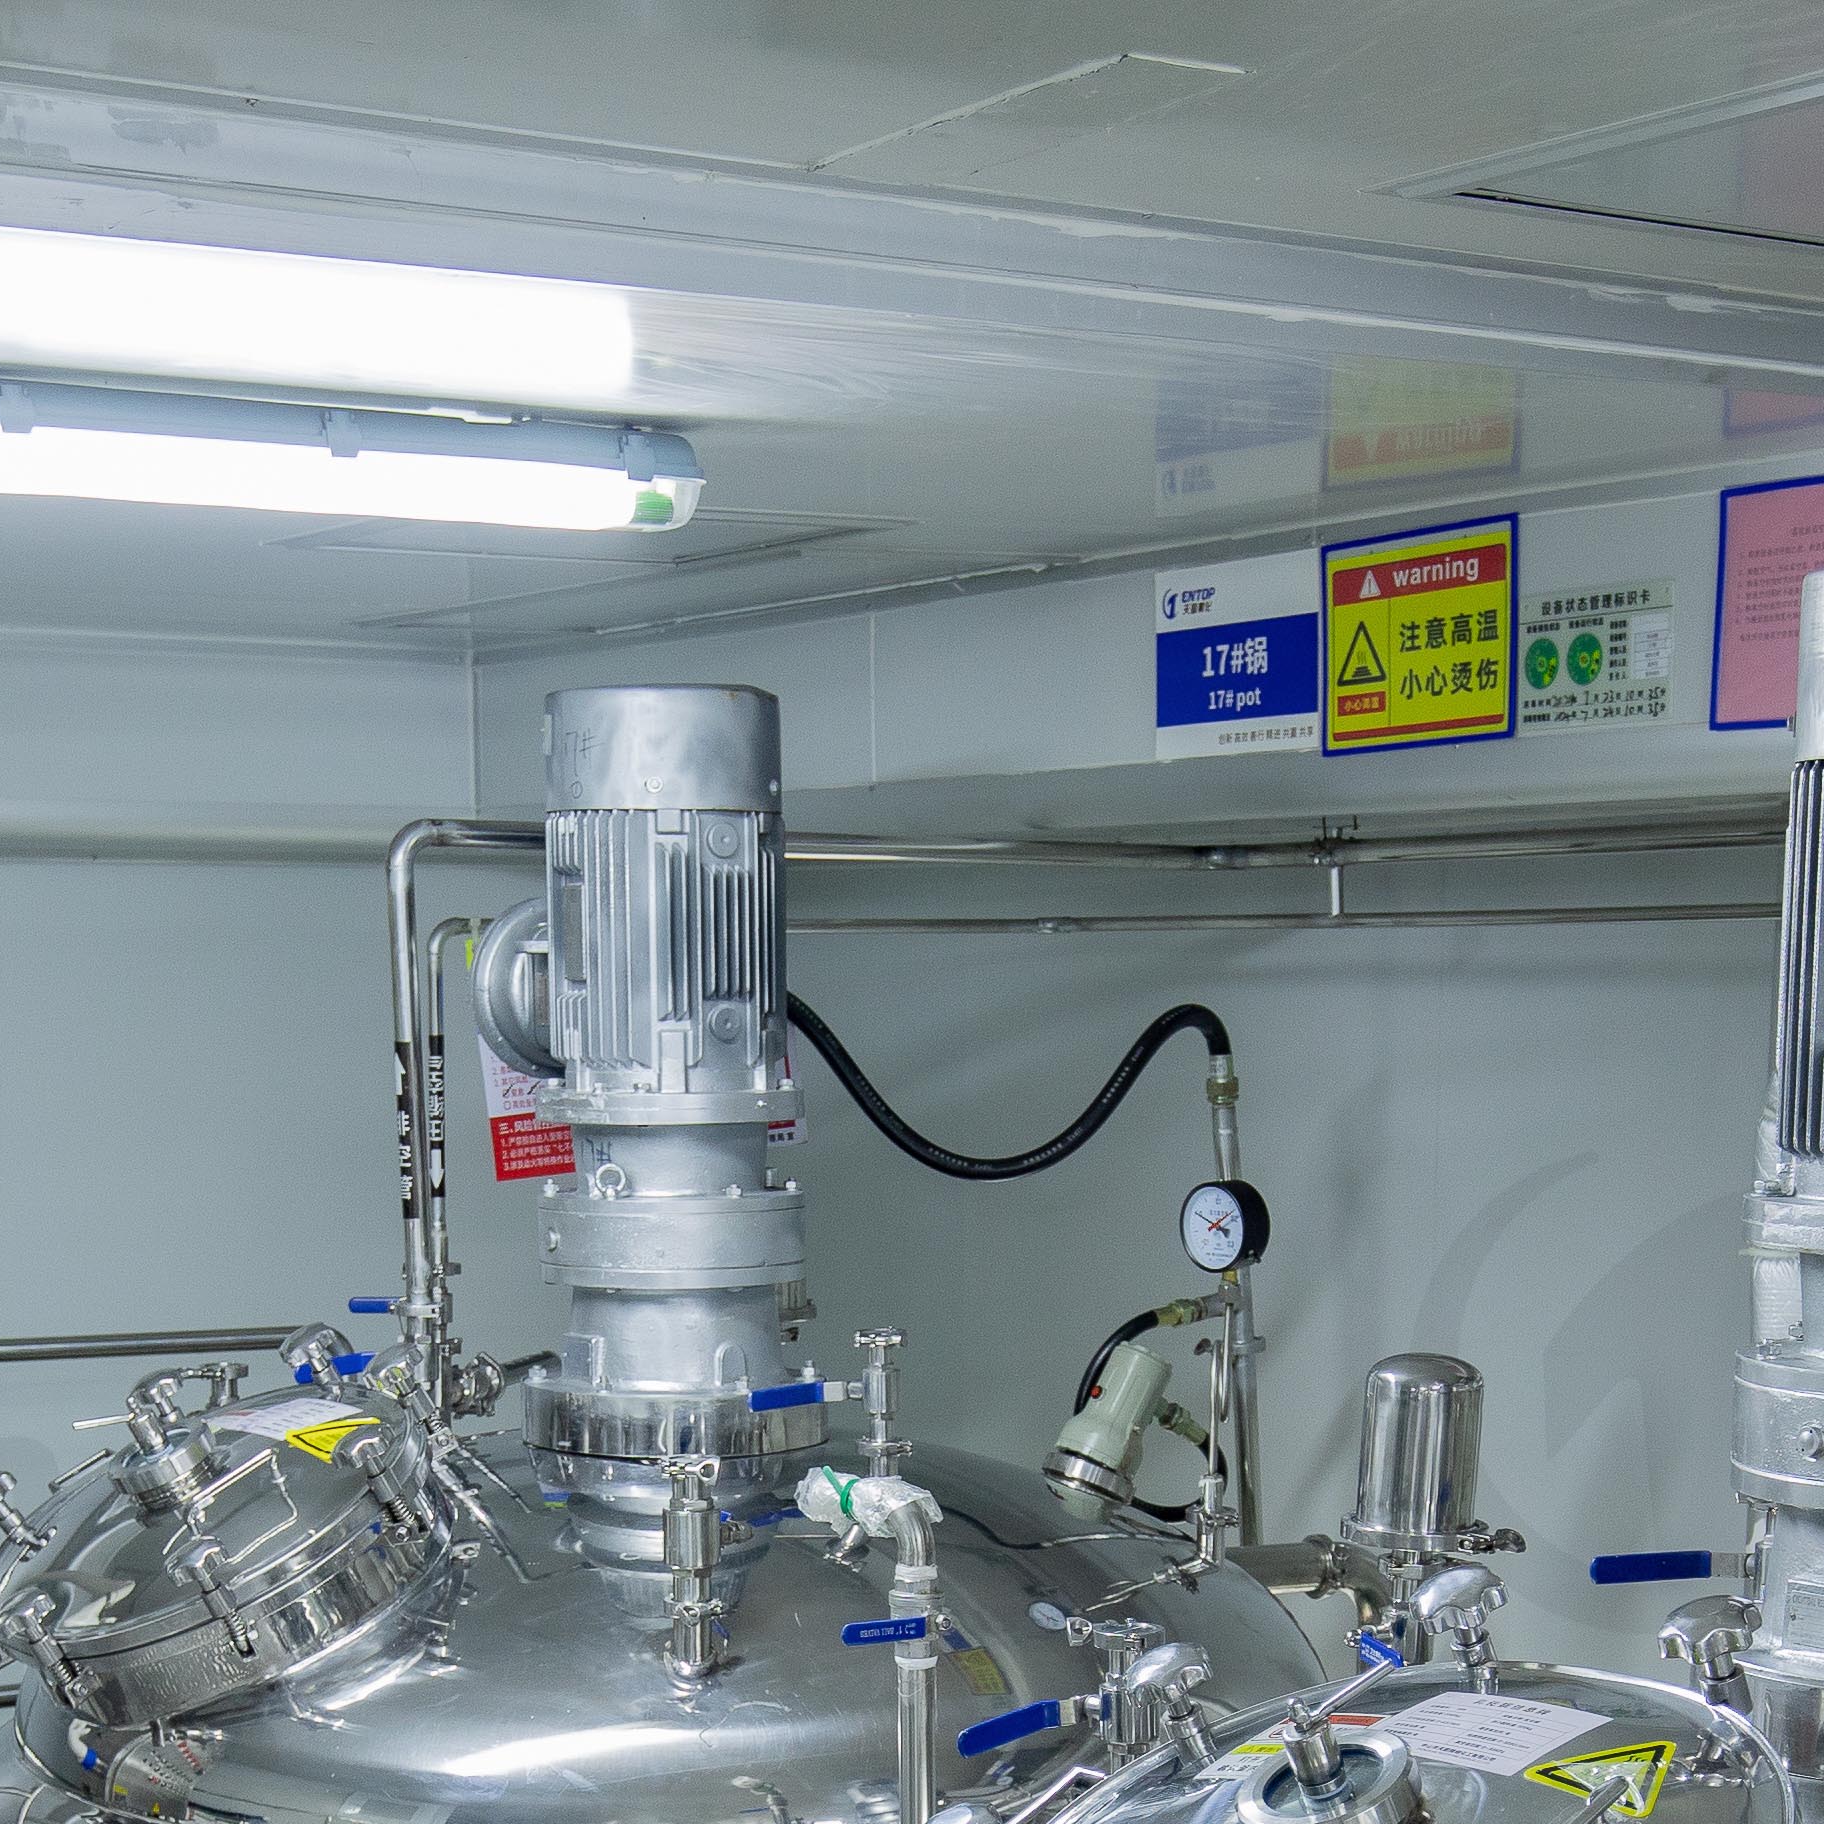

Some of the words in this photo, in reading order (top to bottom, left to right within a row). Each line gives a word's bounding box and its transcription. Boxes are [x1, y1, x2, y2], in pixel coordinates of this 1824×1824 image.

[1392, 556, 1479, 588] warning
[1540, 588, 1651, 616] 设备状态管理标识卡
[1399, 608, 1499, 653] 注意高温
[1202, 636, 1268, 678] 17#锅
[1399, 658, 1499, 700] 小心烫伤
[1208, 689, 1234, 710] 17#
[1236, 687, 1262, 711] pot
